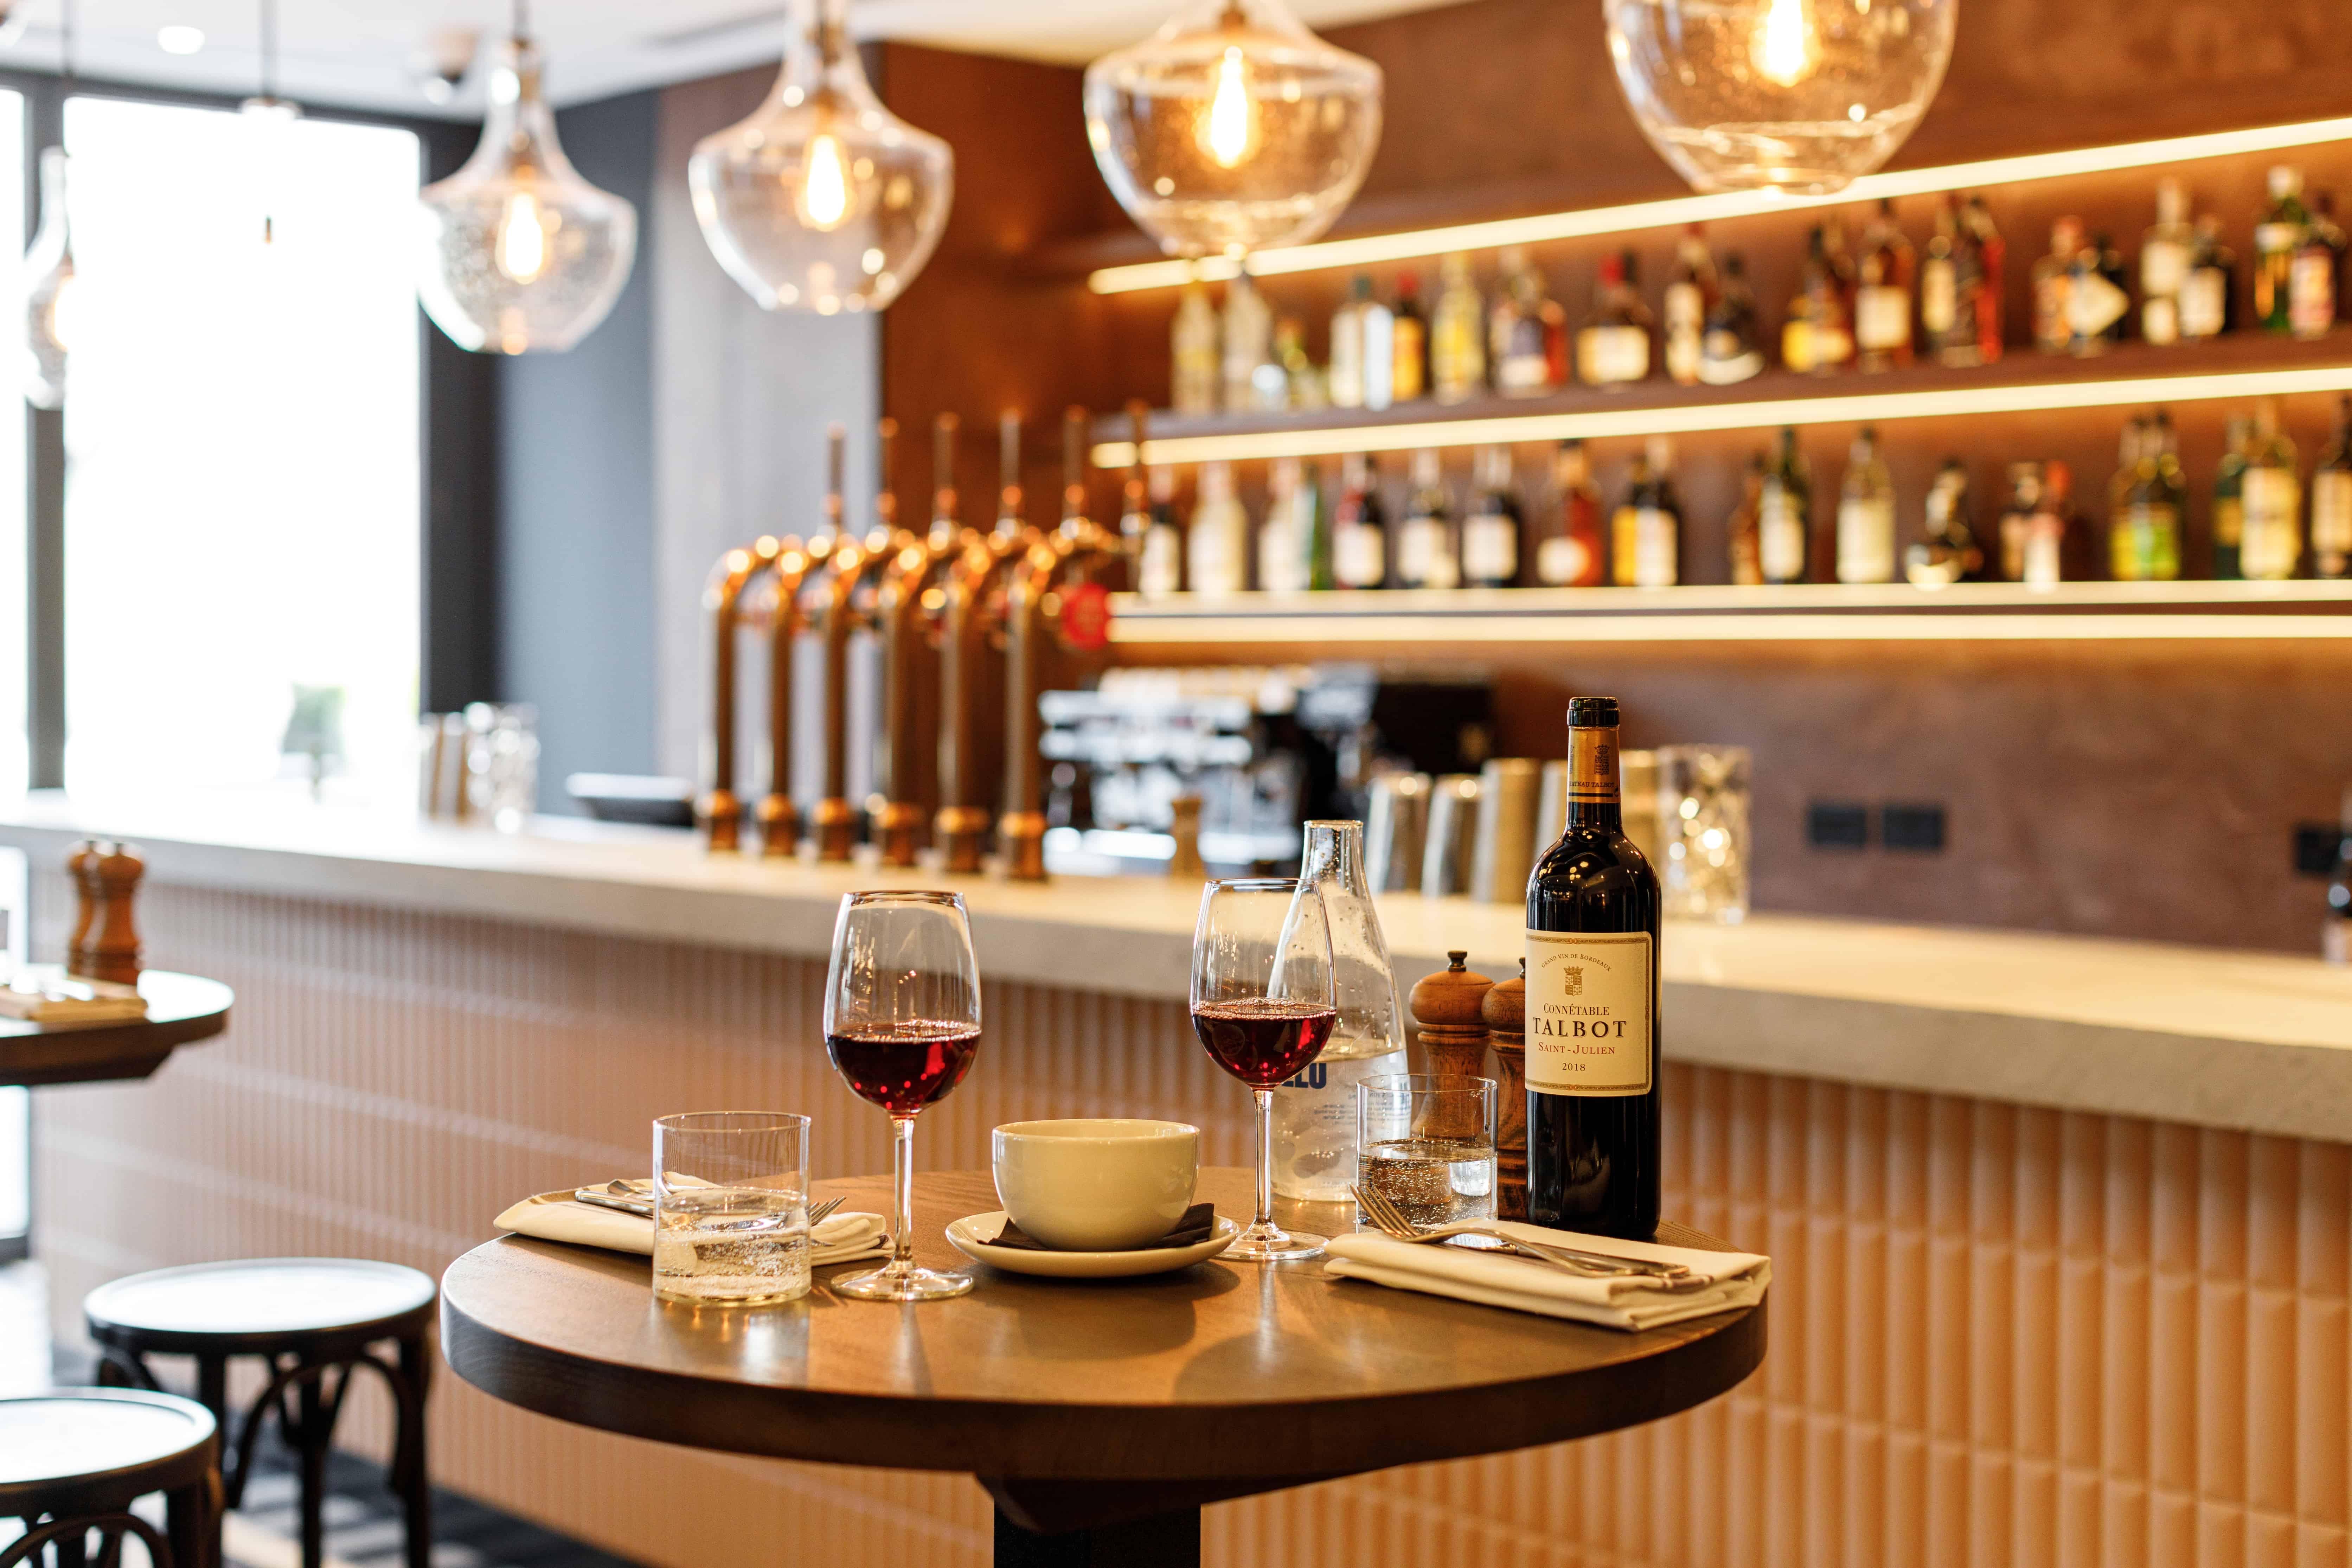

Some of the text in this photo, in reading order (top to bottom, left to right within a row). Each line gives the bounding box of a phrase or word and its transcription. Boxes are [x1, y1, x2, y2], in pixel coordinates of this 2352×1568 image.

[1542, 956, 1557, 968] GRAND
[1580, 954, 1611, 972] BORDEAUX
[1544, 1003, 1609, 1016] CONNÉTABLE
[1532, 1017, 1627, 1038] TALBOT
[1562, 1062, 1586, 1071] 2018
[1282, 1063, 1327, 1089] LU
